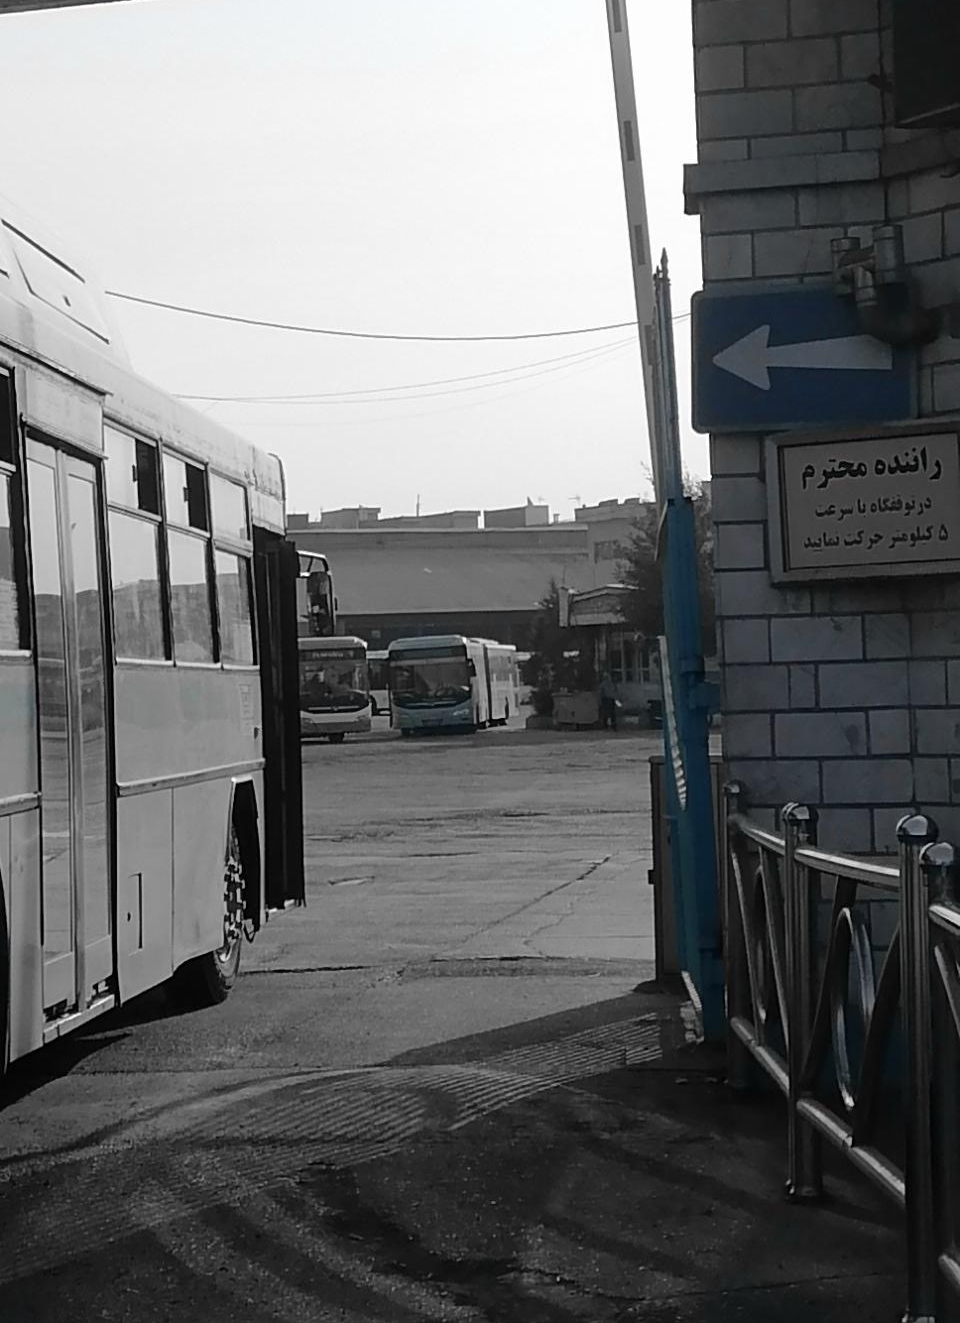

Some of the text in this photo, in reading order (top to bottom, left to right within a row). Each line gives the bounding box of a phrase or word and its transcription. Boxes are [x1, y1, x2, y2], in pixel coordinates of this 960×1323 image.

[801, 445, 943, 490] راننده محترم
[814, 502, 854, 521] سرعت
[857, 498, 866, 518] با
[803, 523, 949, 552] ۵ کیلومتر حرکت نمایید
